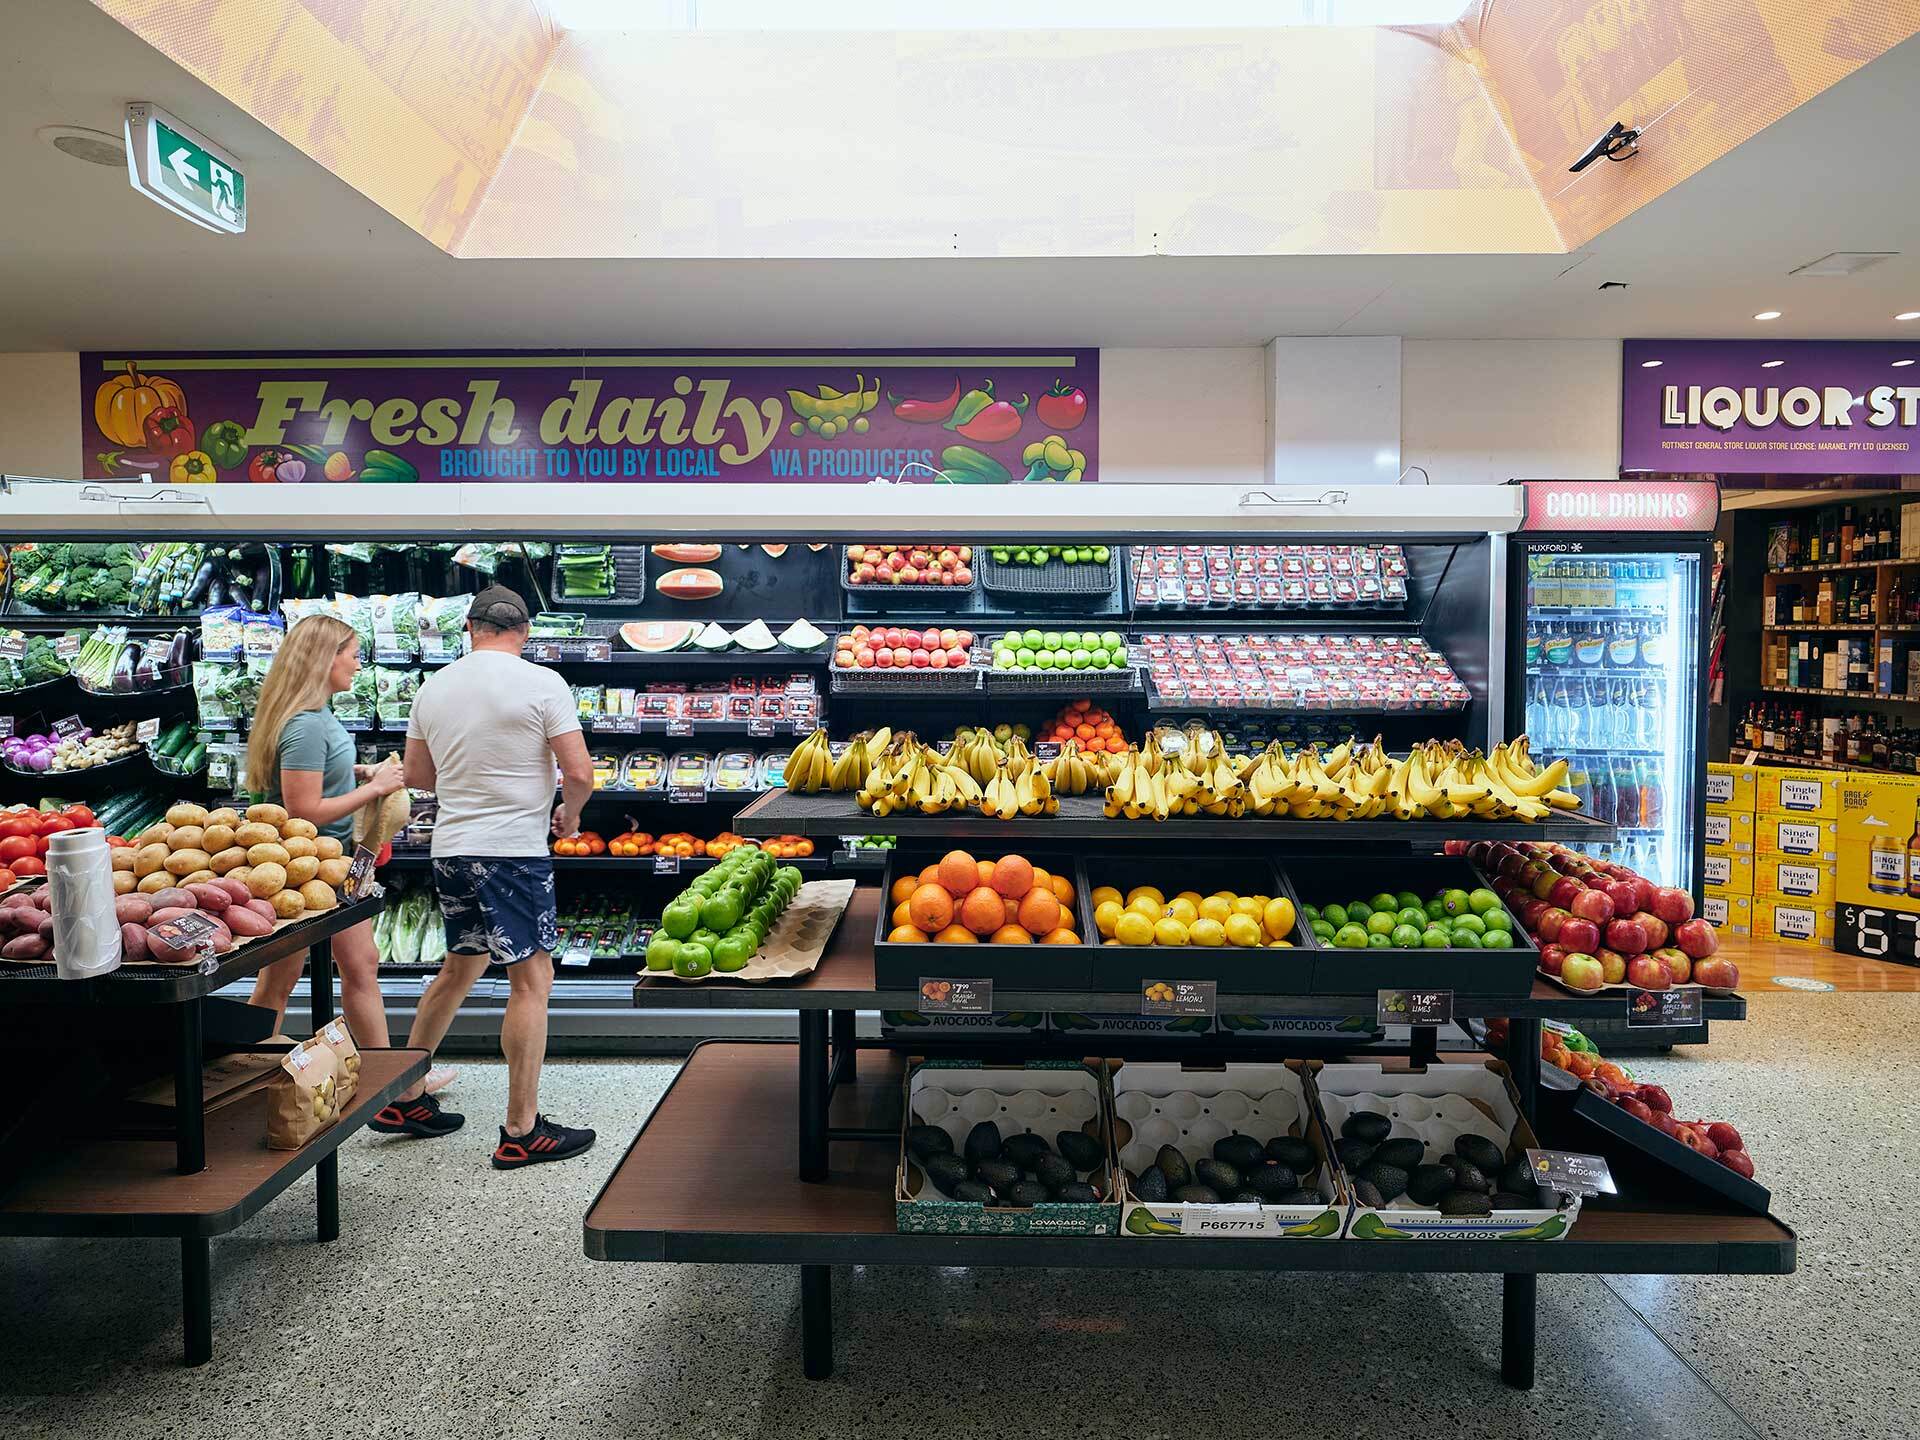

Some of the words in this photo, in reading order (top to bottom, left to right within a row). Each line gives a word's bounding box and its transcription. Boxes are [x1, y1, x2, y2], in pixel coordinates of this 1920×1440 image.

[1661, 384, 1853, 431] LIQUOR
[246, 380, 521, 446] Fresh
[538, 375, 784, 465] daily
[1661, 441, 1693, 450] ROTTNEST
[1694, 441, 1723, 450] GENERAL
[1724, 441, 1744, 450] STORE
[1745, 441, 1767, 451] LIQUOR
[1768, 442, 1789, 451] STORE
[1818, 442, 1847, 451] MARANEL
[1848, 442, 1861, 451] PTY
[1862, 443, 1875, 451] LTD
[1876, 443, 1910, 452] (LICENSEE)
[439, 449, 538, 478] BROUGHT
[543, 449, 570, 478] TO
[575, 449, 617, 478] YOU
[623, 449, 650, 478] BY
[655, 449, 720, 478] LOCAL
[769, 449, 803, 478] WA
[807, 449, 934, 478] PRODUCERS
[1546, 492, 1603, 518] COOL
[1608, 492, 1689, 518] DRINKS
[1527, 544, 1567, 552] HUXFORD
[1785, 785, 1817, 795] Single
[1792, 793, 1810, 801] Fin
[1783, 828, 1815, 838] Single
[1790, 837, 1807, 845] Fin
[1881, 864, 1896, 872] FIN
[1783, 869, 1815, 880] Single
[1790, 878, 1807, 886] Fin
[1779, 912, 1811, 923] Single
[1786, 921, 1804, 929] Fin
[1175, 994, 1204, 1003] LEMONS
[1412, 1005, 1431, 1013] LIMES
[933, 1016, 993, 1027] AVOCADOS
[1102, 1020, 1163, 1031] AVOCADOS
[1272, 1021, 1333, 1031] AVOCADOS
[1567, 1168, 1604, 1178] AVOCADO
[1200, 1221, 1265, 1230] P667715
[1416, 1231, 1498, 1240] AVOCADOS
